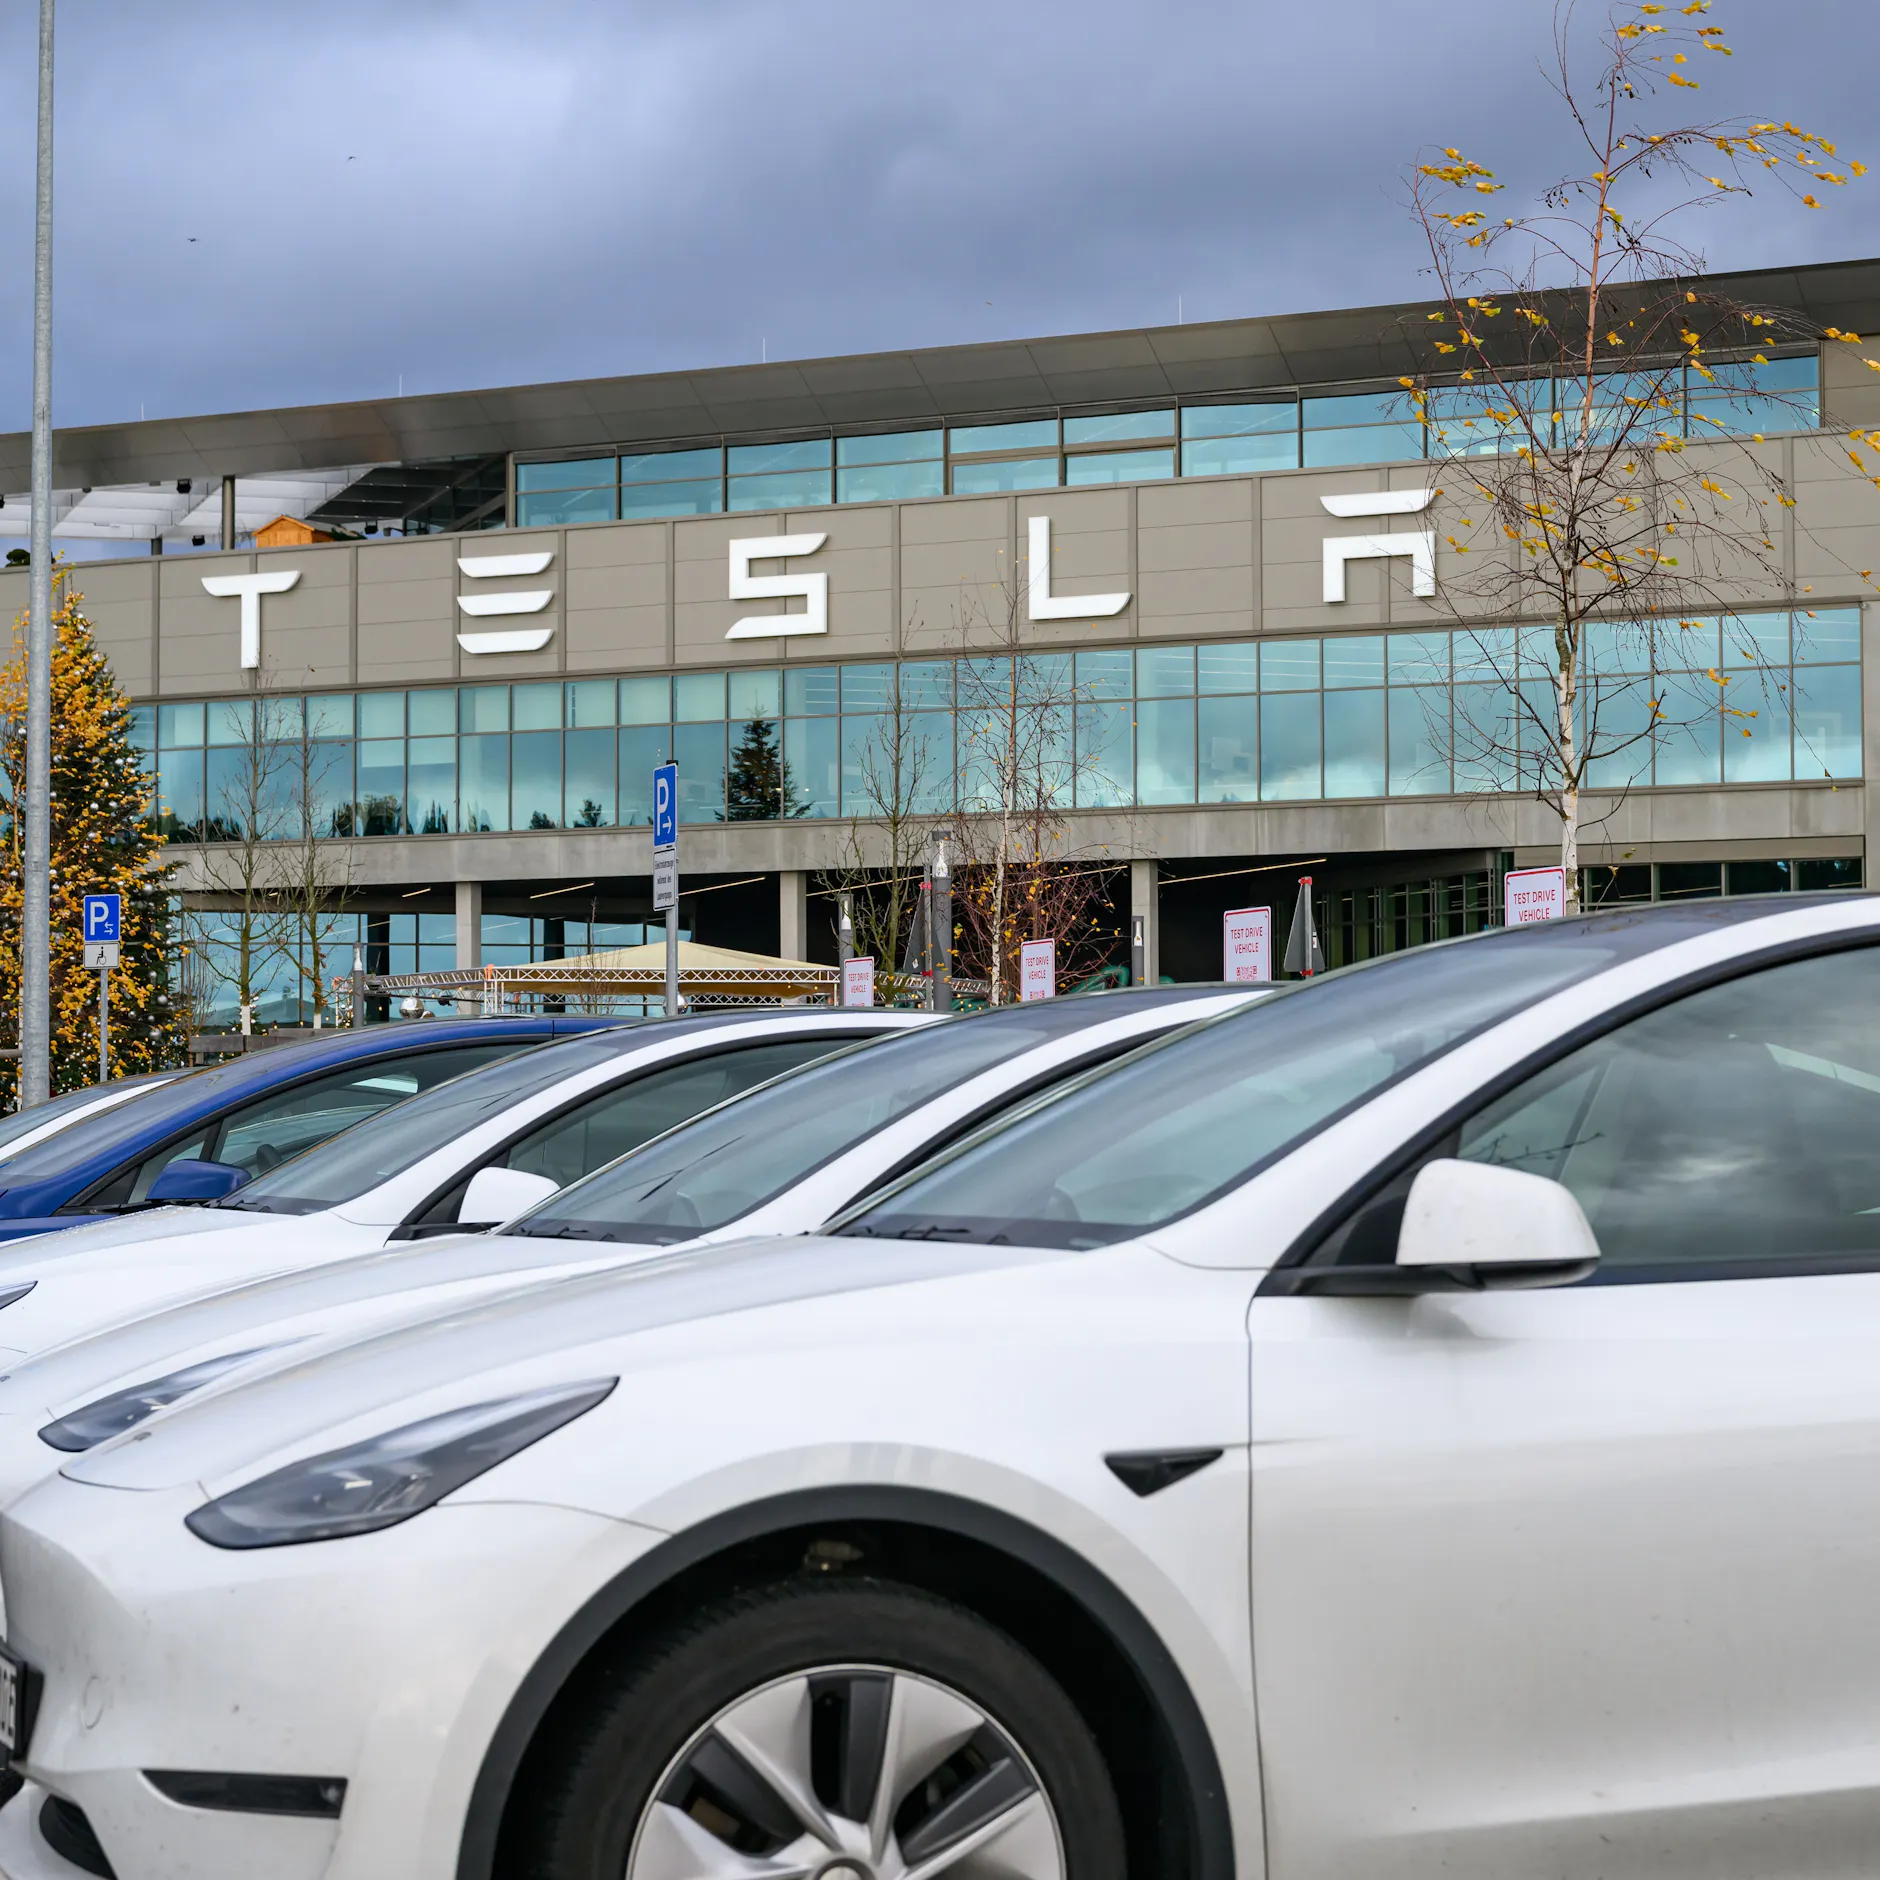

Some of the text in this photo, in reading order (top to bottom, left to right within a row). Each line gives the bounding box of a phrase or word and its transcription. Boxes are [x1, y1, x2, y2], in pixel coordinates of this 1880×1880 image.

[200, 488, 1437, 669] TESLA
[656, 777, 669, 837] P
[1513, 889, 1556, 905] TEST DRIVE
[90, 901, 109, 936] P
[1518, 907, 1551, 922] VEHICLE
[1230, 926, 1263, 939] TEST DRIVE
[1234, 942, 1259, 954] VEHICLE
[1025, 955, 1049, 967] TEST DRIVE
[1028, 970, 1046, 980] VEHICLE
